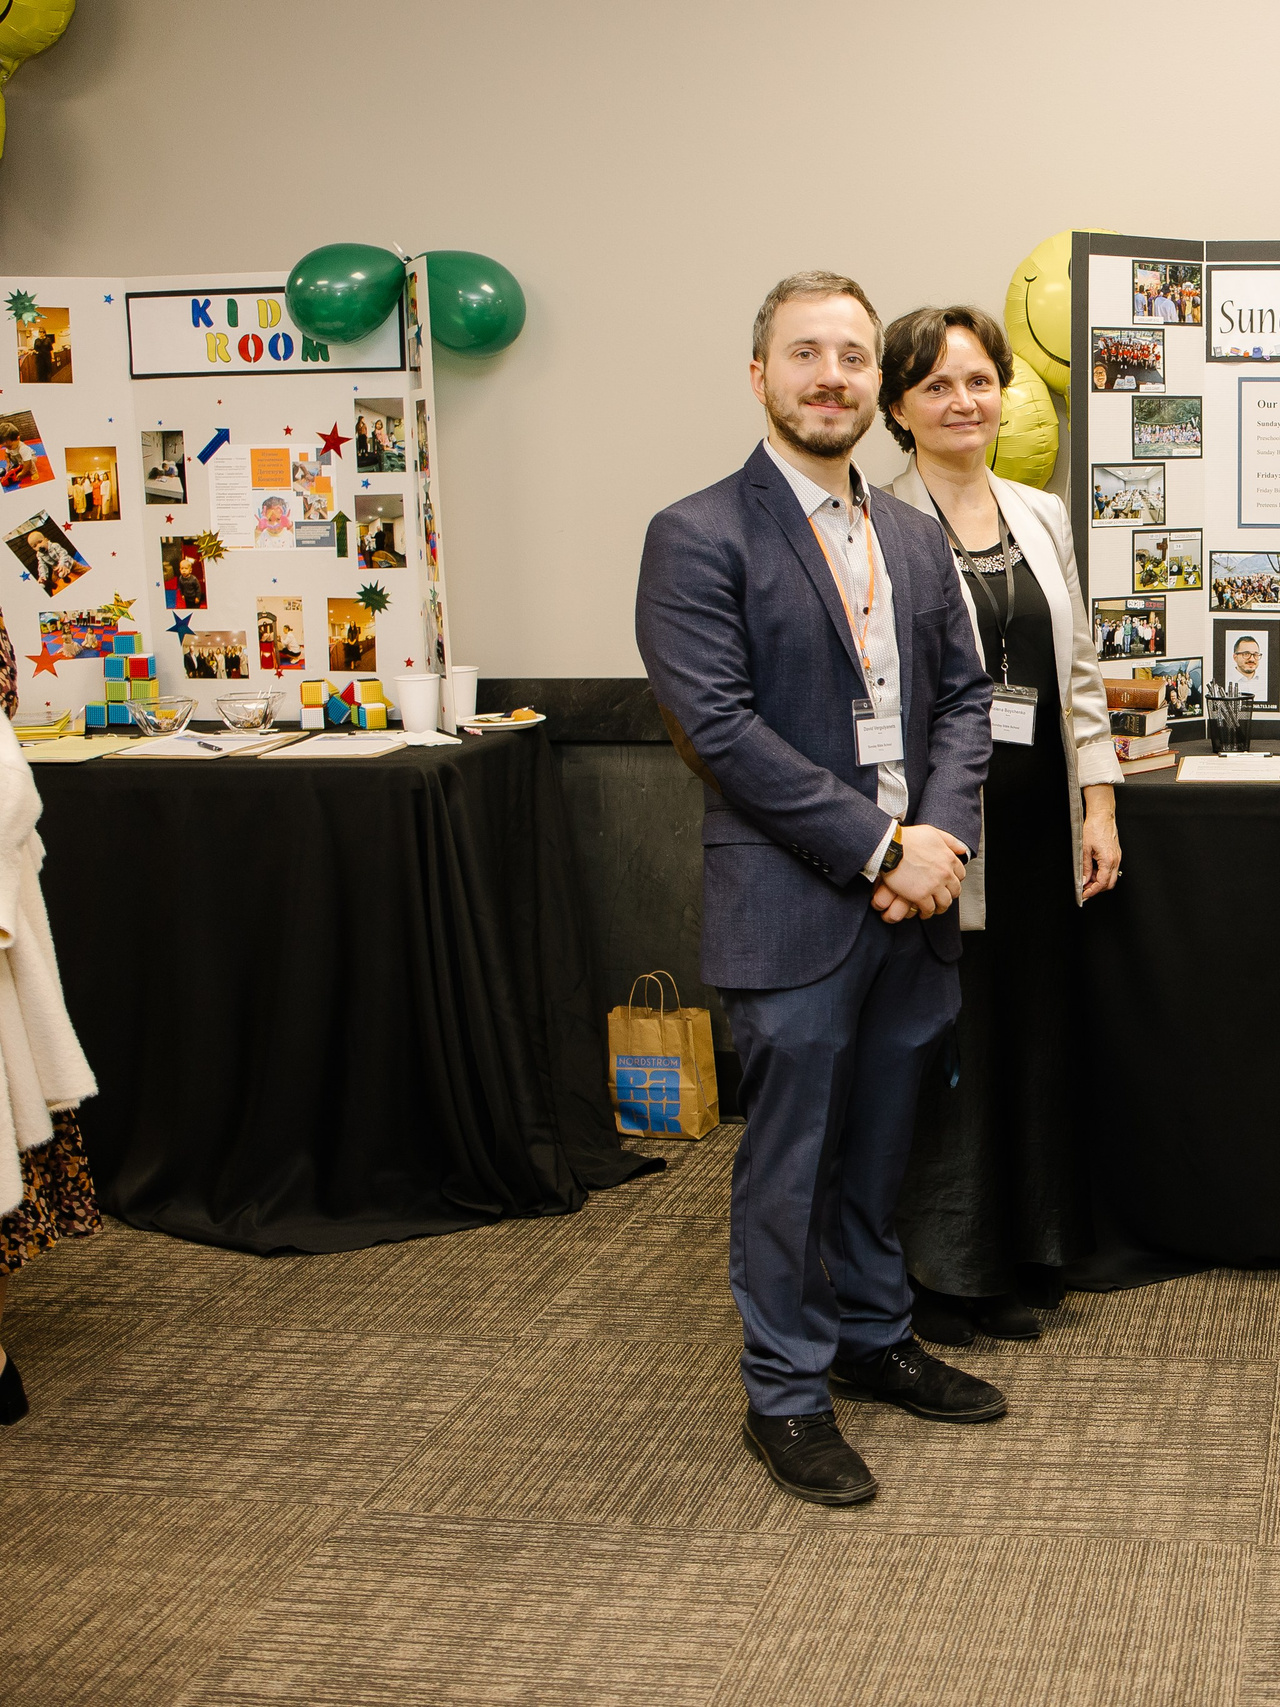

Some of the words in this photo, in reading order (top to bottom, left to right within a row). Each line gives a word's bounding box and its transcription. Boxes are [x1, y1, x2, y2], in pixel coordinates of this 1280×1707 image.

[191, 298, 282, 329] KID
[205, 332, 330, 363] ROOM
[1257, 400, 1278, 409] Our
[1256, 472, 1280, 480] Friday:
[619, 1057, 678, 1067] NORDSTROM
